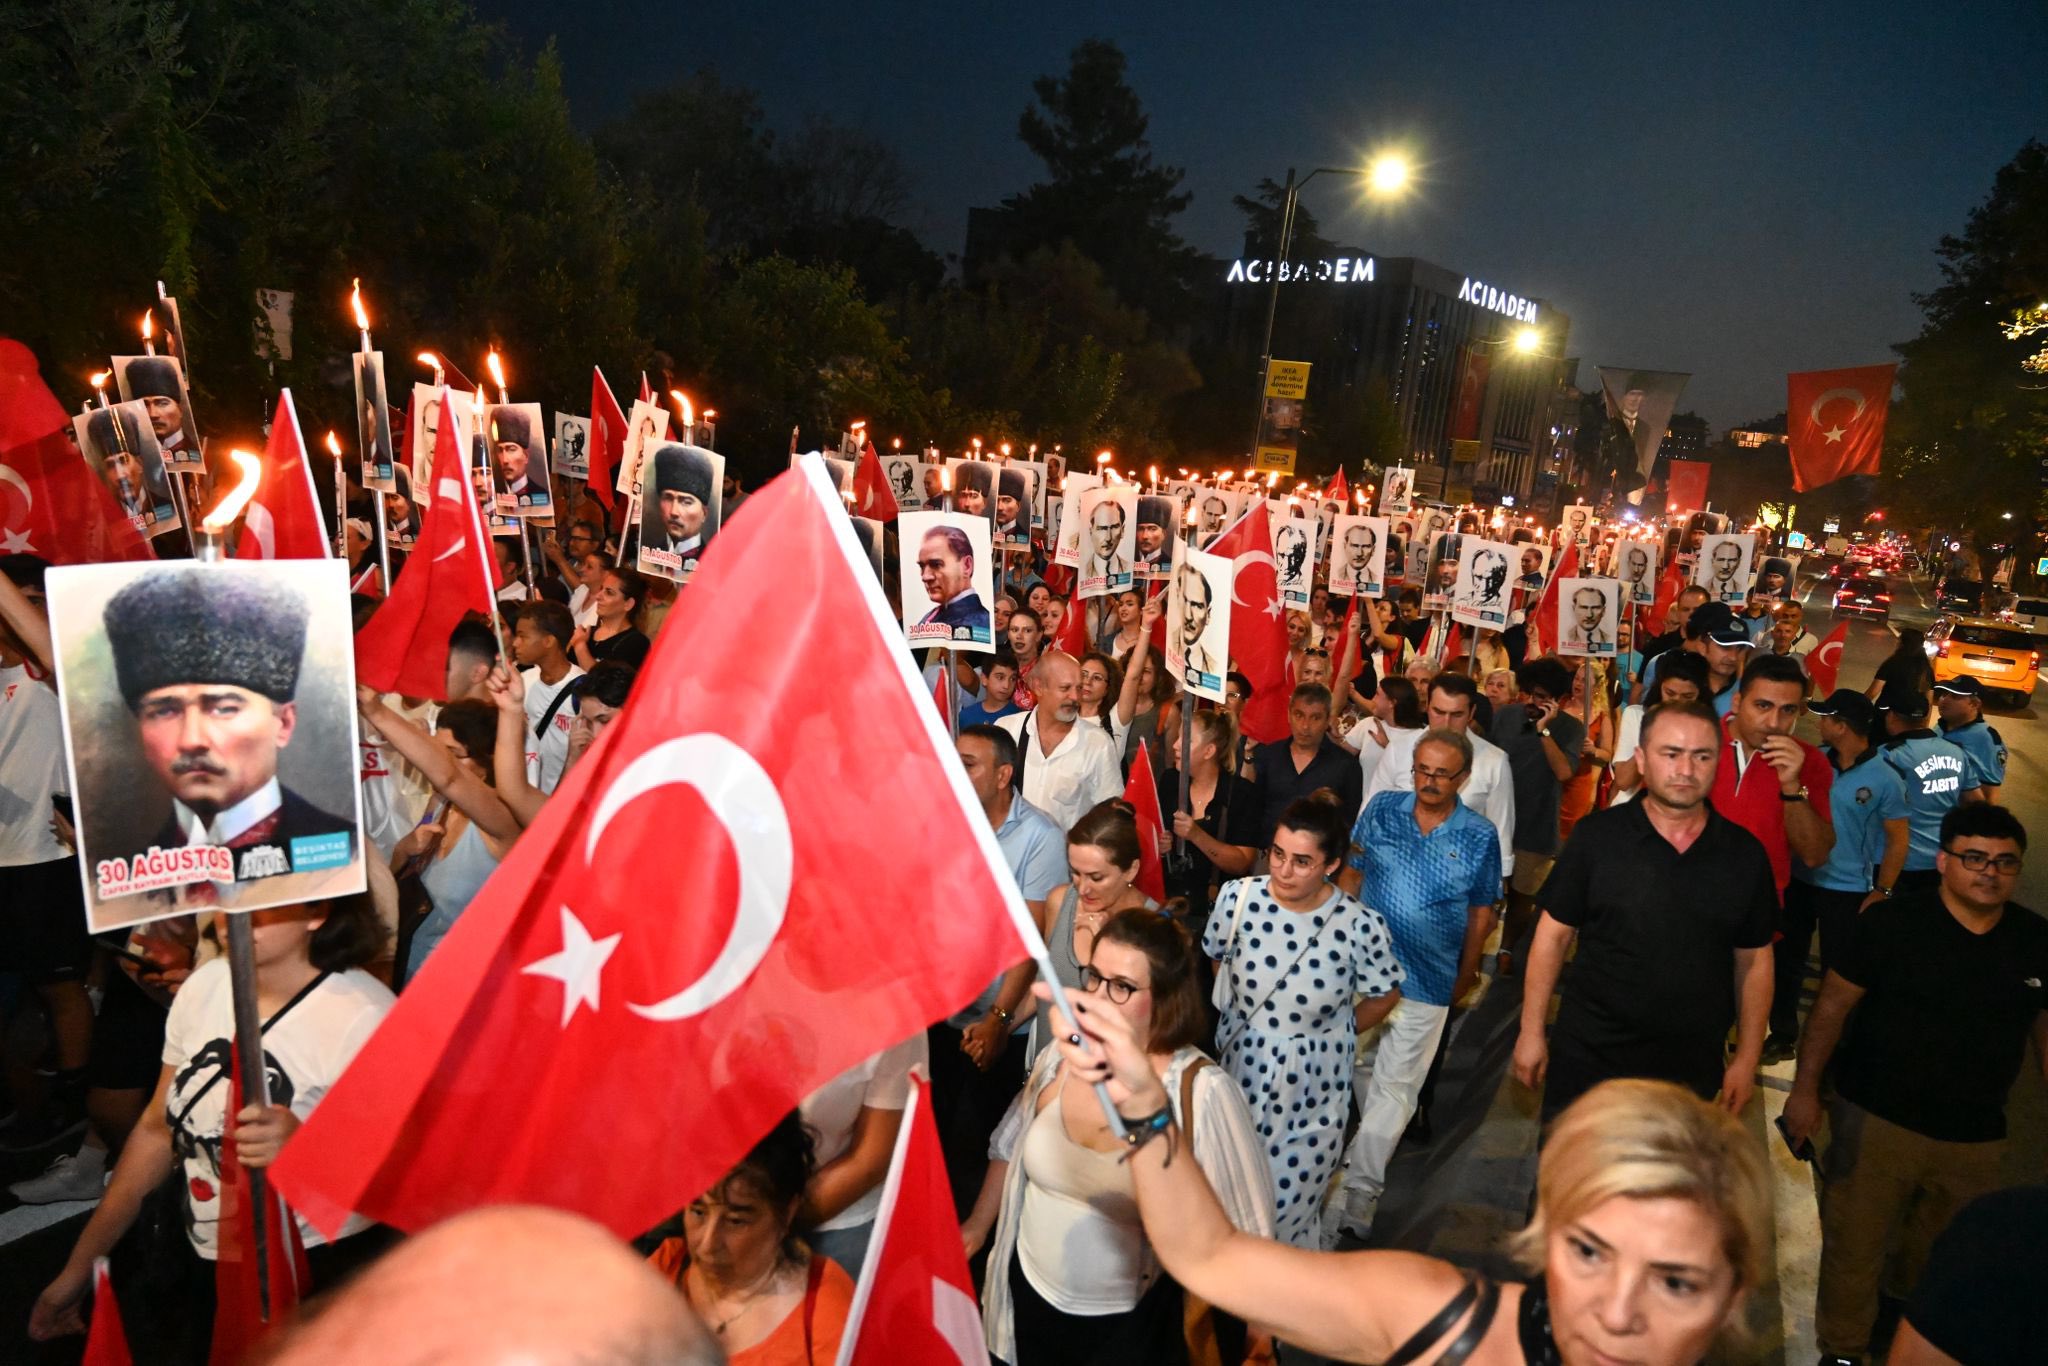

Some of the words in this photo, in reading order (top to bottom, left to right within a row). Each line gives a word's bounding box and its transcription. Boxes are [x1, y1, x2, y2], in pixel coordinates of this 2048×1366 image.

[1458, 277, 1537, 325] ACIBADEM
[909, 625, 919, 634] 30
[919, 622, 952, 635] AĞUSTOS
[101, 862, 126, 884] 30
[133, 847, 231, 878] AĞUSTOS
